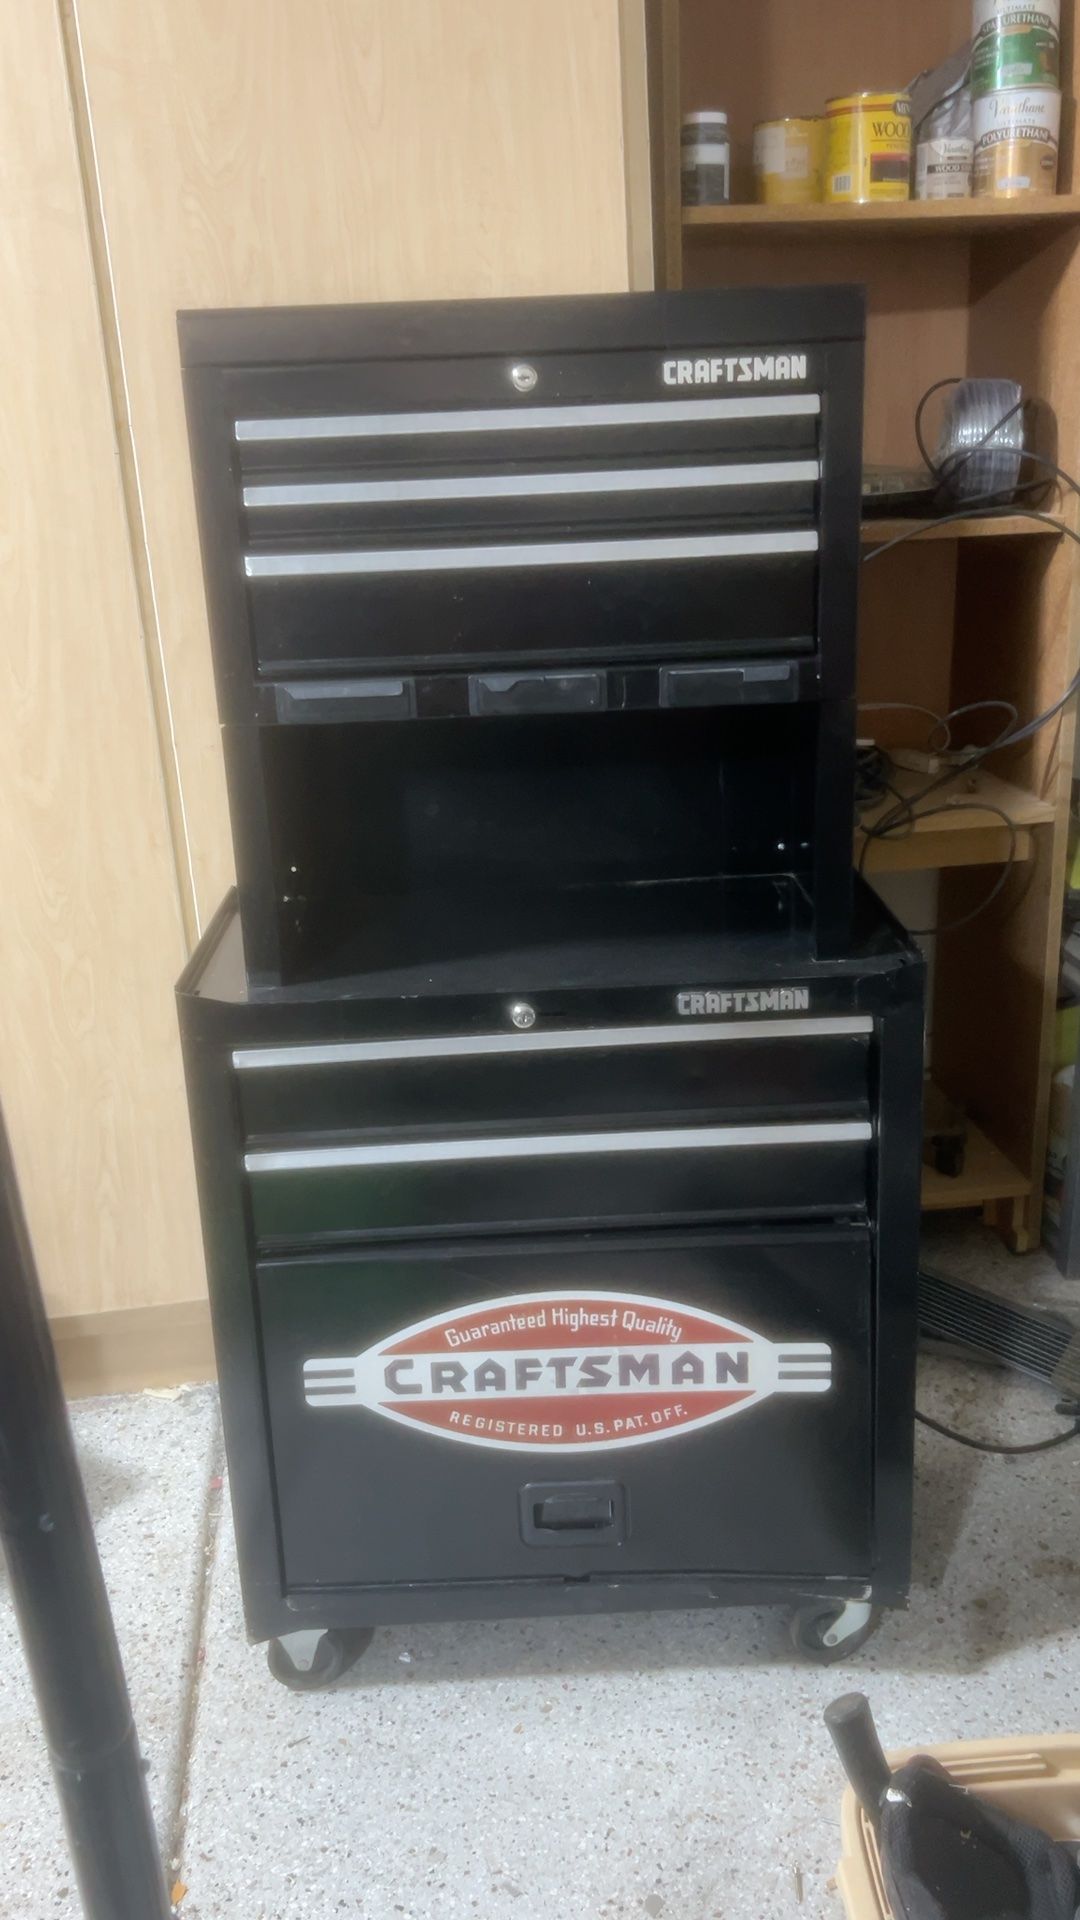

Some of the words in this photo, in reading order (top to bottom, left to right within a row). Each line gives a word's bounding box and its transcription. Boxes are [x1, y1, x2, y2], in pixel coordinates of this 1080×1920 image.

[662, 355, 807, 386] CRAFTSMAN
[676, 986, 810, 1016] CRAFTSMAN
[445, 1309, 547, 1348] Guaranteed
[551, 1307, 619, 1333] Highest
[622, 1310, 683, 1343] Quality
[384, 1351, 750, 1395] CRAFTSMAN
[449, 1410, 564, 1437] REGISTERED
[576, 1422, 611, 1435] U.S.
[614, 1413, 648, 1431] PAT.
[651, 1404, 689, 1423] OFF.
